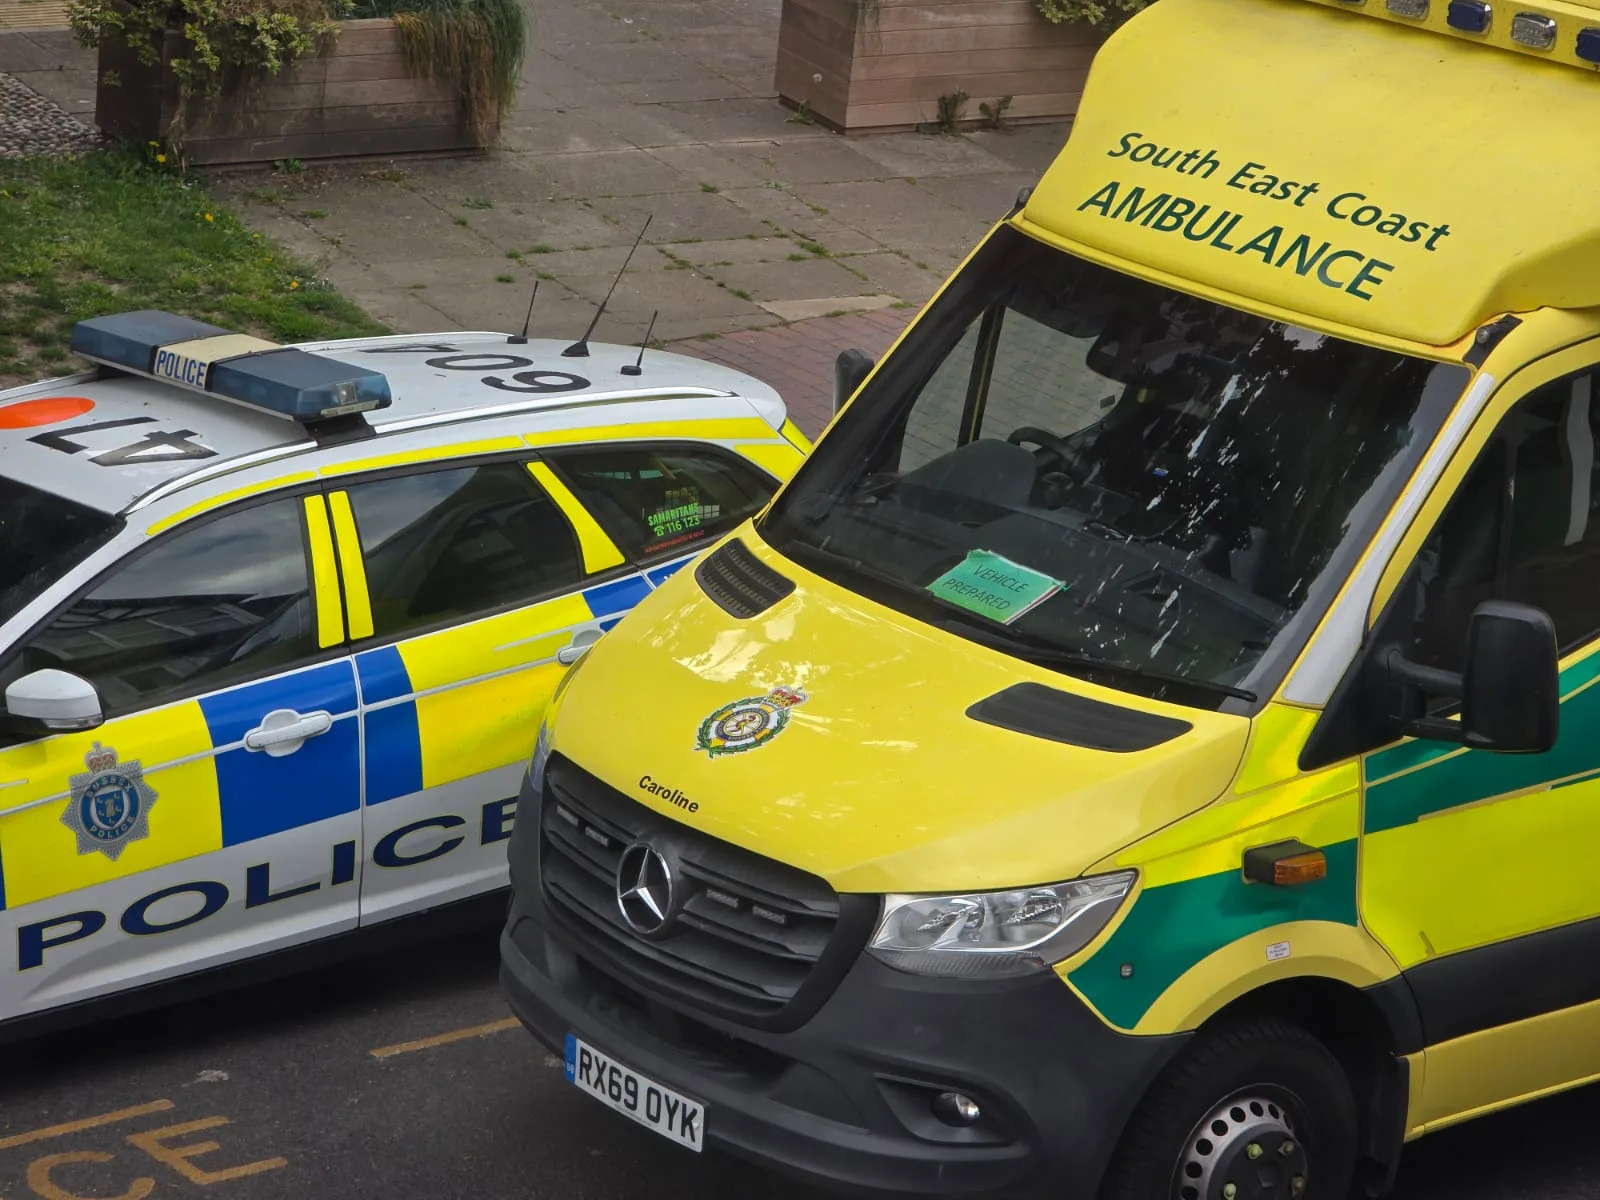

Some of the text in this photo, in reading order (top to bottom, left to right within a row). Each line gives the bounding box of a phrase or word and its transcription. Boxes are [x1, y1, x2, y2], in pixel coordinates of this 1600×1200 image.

[1107, 132, 1451, 251] South East Coast
[1077, 181, 1395, 301] AMBULANCE
[156, 350, 207, 387] POLICE
[667, 515, 700, 533] 116 123
[942, 578, 1011, 610] PREPARED
[973, 564, 1029, 593] VEHICLE
[639, 775, 699, 813] Caroline
[89, 815, 137, 839] POLICE
[579, 1046, 638, 1111] RX69
